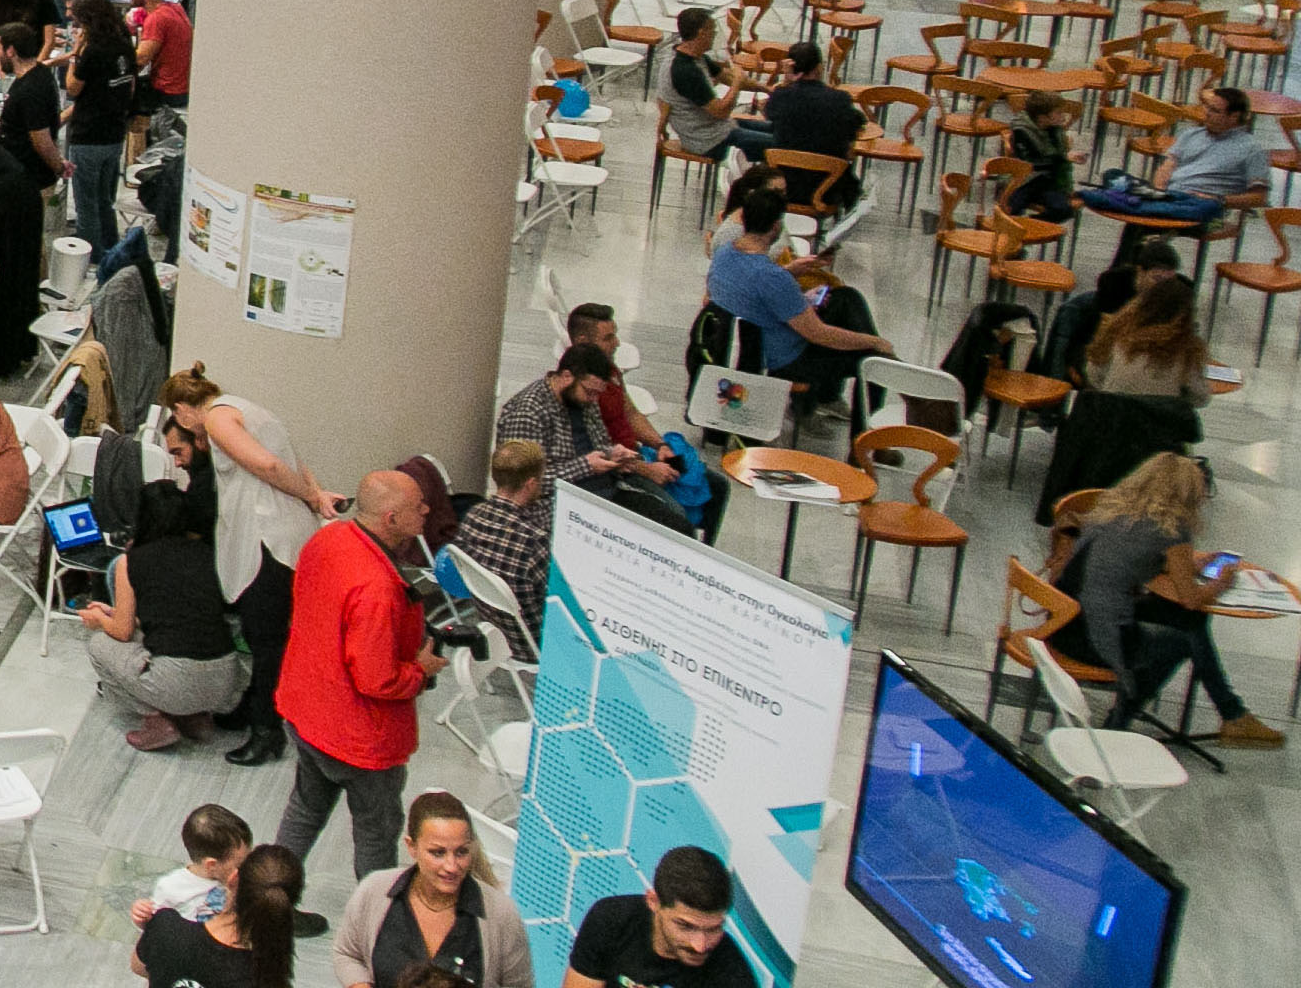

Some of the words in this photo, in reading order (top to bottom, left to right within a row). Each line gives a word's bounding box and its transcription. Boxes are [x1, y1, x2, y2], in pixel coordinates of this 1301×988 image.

[738, 592, 766, 612] στην
[585, 607, 597, 623] Ο
[601, 617, 668, 660] ΑΣΘΕΝΗΣ
[671, 650, 698, 673] ΣΤΟ
[702, 665, 783, 717] ΕΠΙΚΕΝΤΡΟ
